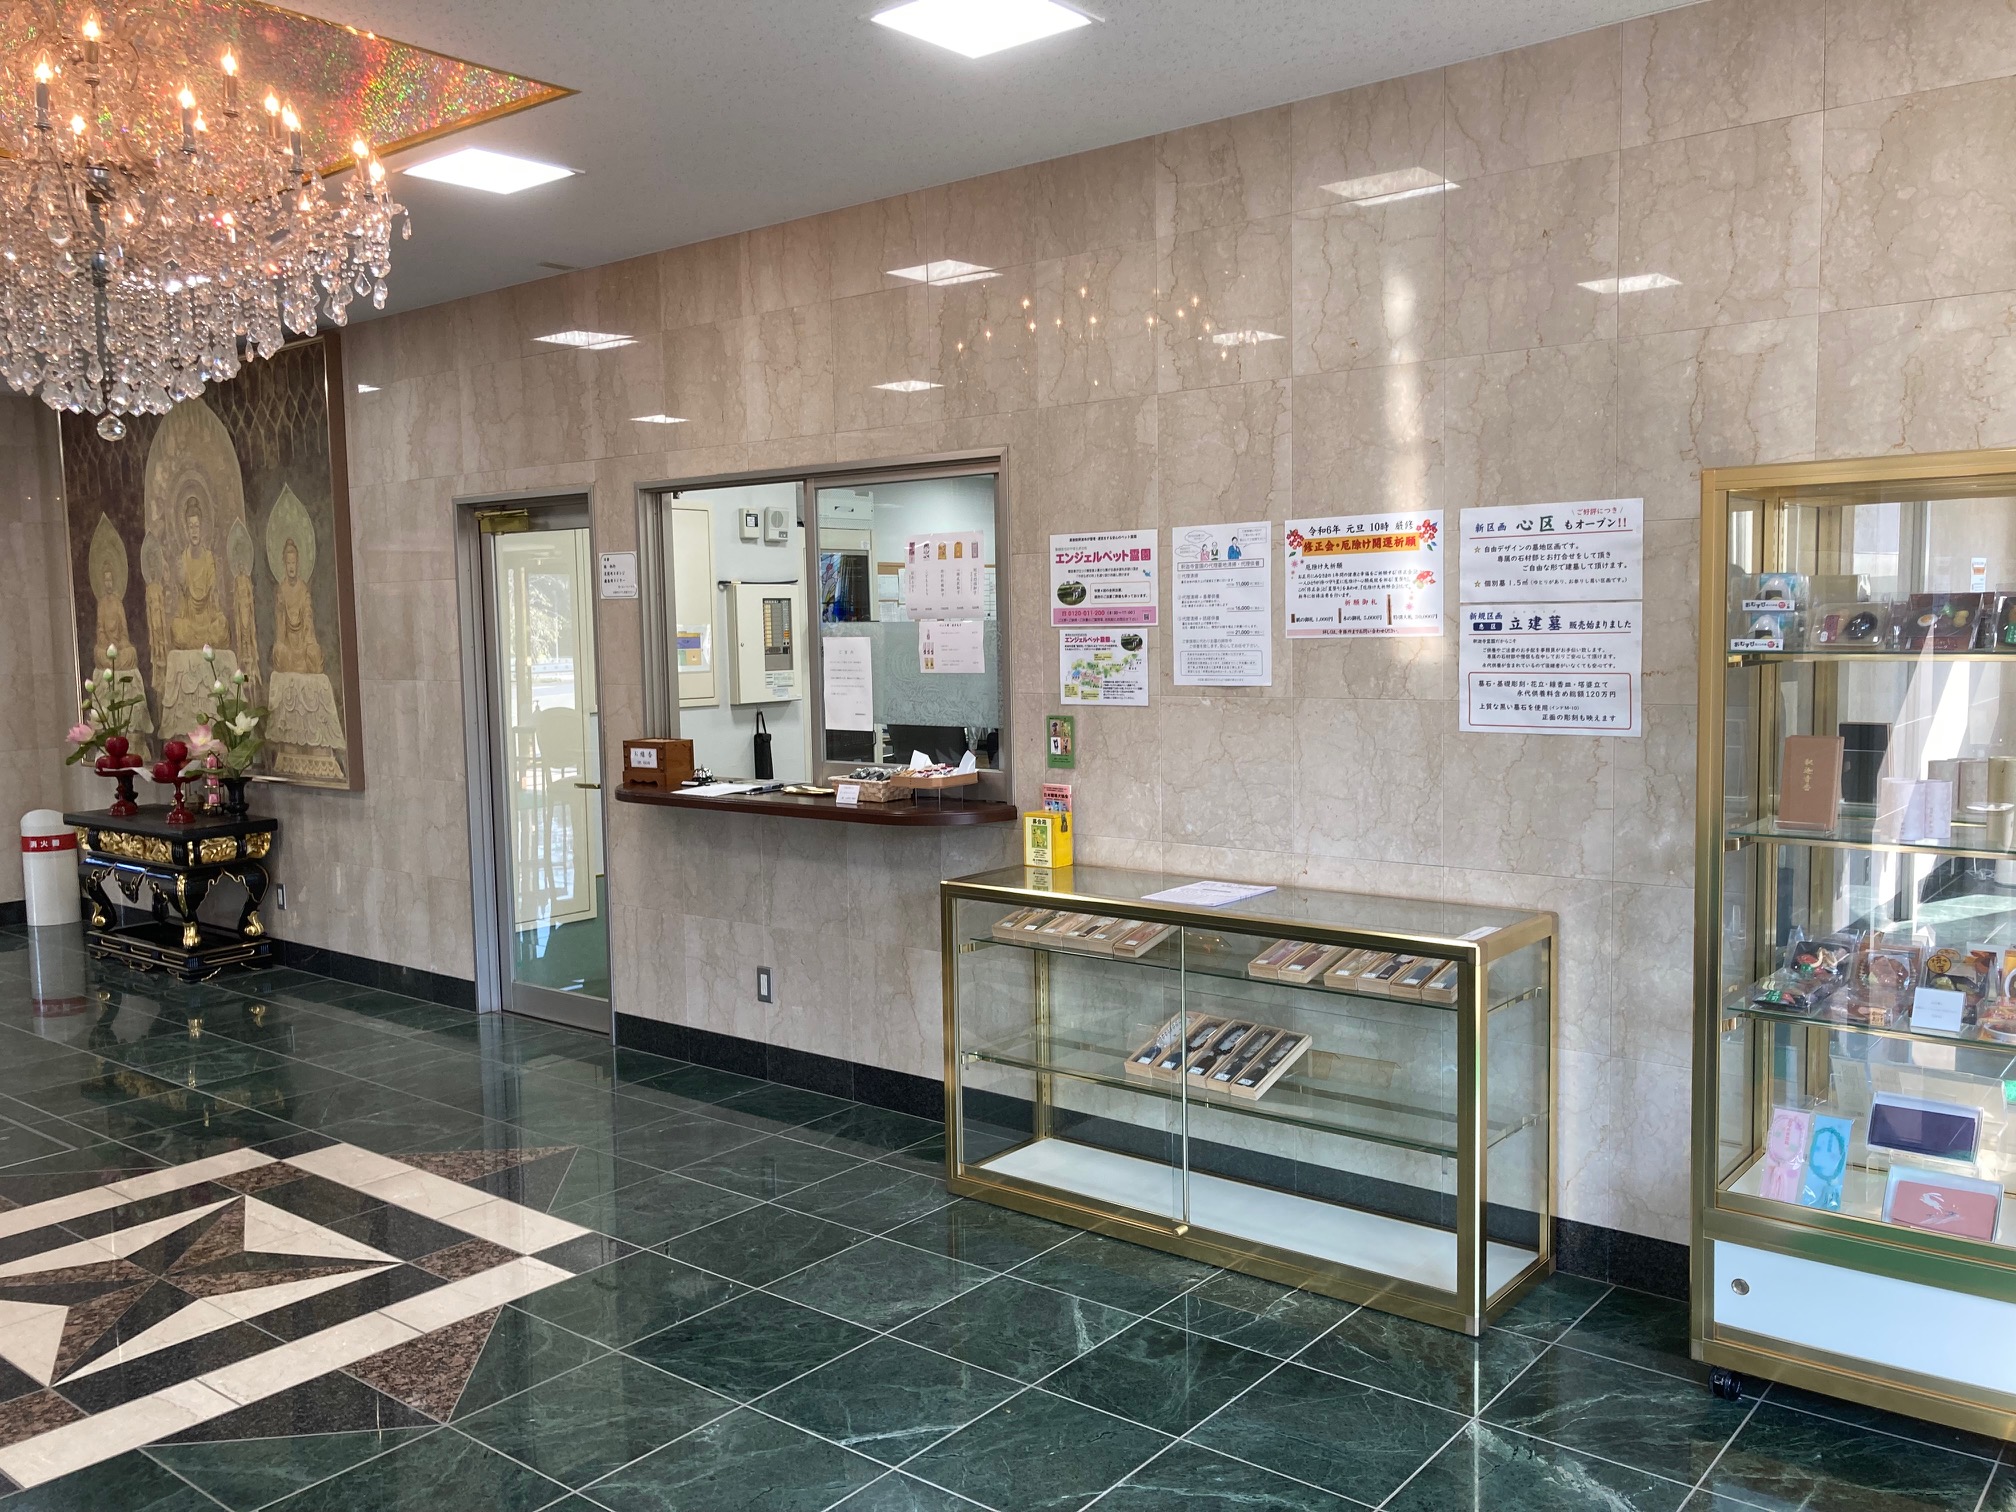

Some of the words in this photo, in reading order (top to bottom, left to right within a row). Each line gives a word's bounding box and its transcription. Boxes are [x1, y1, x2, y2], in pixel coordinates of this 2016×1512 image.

[1576, 507, 1618, 516] ご好評につき
[1475, 522, 1507, 533] 新区画
[1516, 515, 1555, 533] 心区
[1308, 525, 1341, 536] 令和6年
[1346, 523, 1365, 534] 元旦
[1370, 522, 1390, 532] 10時
[1303, 535, 1418, 553] 修正会・厄除け開運祈願
[1484, 542, 1580, 553] 自由デザインの墓地区画です。
[1055, 548, 1152, 564] エンジェルペット霊園
[1305, 562, 1343, 571] 厄除け大祈願
[1484, 579, 1506, 588] 個別墓
[1344, 598, 1378, 606] 祈願御札
[1469, 612, 1502, 621] 新規区画
[1508, 615, 1562, 631] 立建墓
[1568, 620, 1632, 630] 販売始まりました
[1541, 714, 1617, 722] 正面の彫刻も映えます
[29, 839, 60, 848] 消火器
